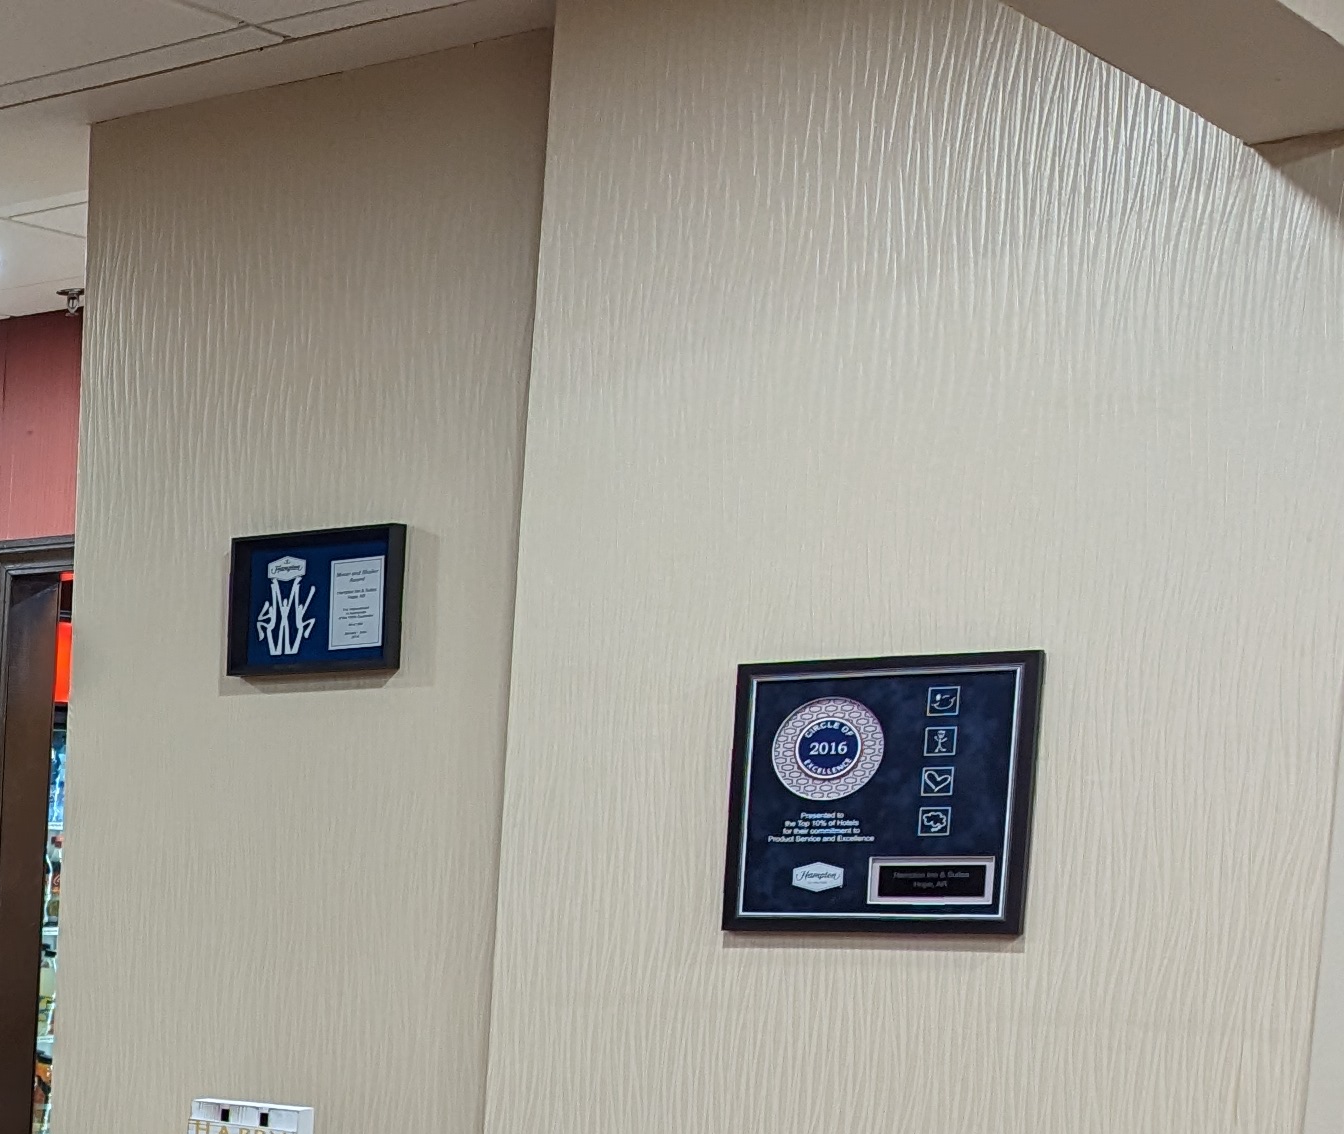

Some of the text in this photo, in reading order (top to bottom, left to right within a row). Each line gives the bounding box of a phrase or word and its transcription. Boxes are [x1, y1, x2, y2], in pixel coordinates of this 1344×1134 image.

[805, 721, 854, 738] CIRCLE OF
[809, 741, 848, 755] 2016
[803, 757, 853, 775] EXCELLENCE
[796, 870, 841, 880] Hampton
